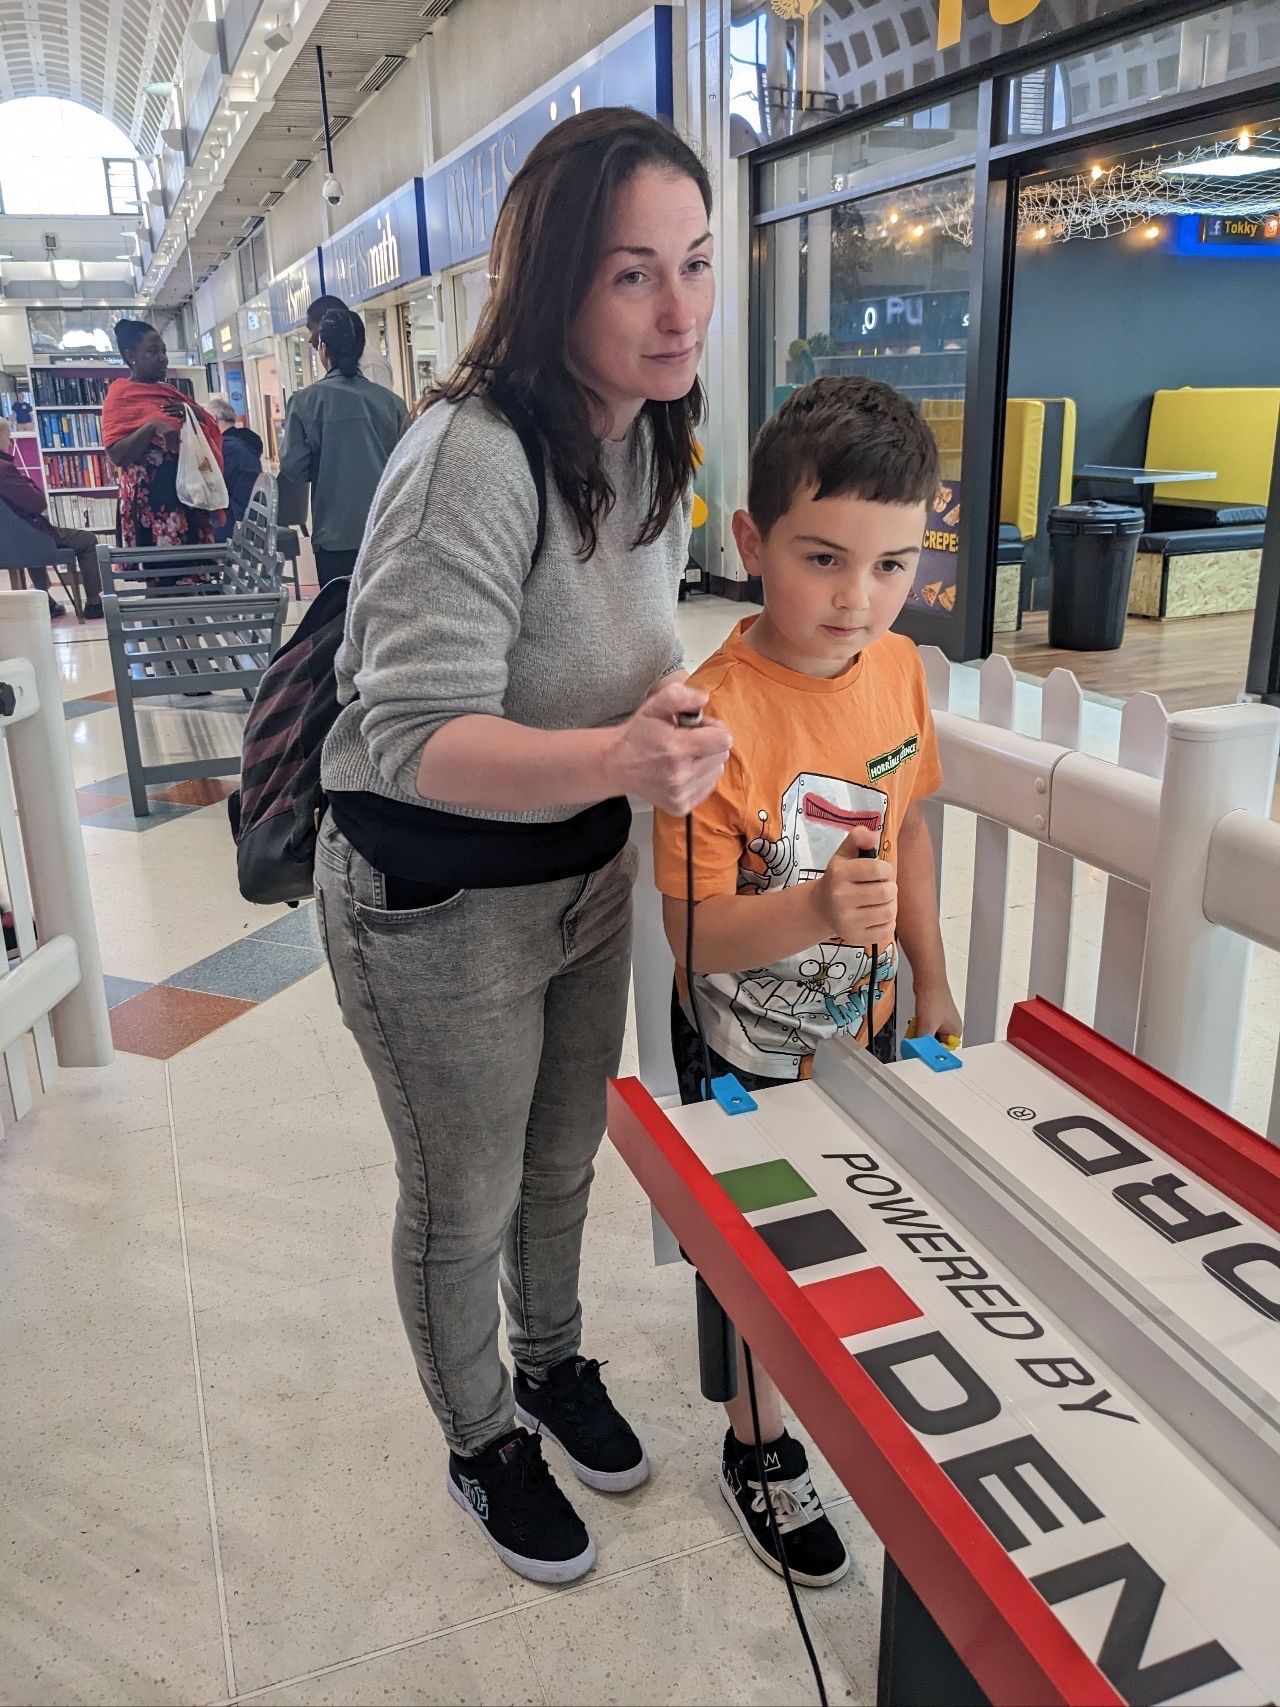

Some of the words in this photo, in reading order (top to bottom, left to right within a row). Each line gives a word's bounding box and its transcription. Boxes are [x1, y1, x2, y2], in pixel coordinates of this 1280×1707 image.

[331, 211, 400, 303] WHSmith
[1225, 220, 1258, 238] Tokky
[870, 754, 900, 778] HORRIBLE
[821, 1153, 1045, 1340] POWERED
[1015, 1357, 1140, 1424] BY
[852, 1330, 1276, 1707] DEN
